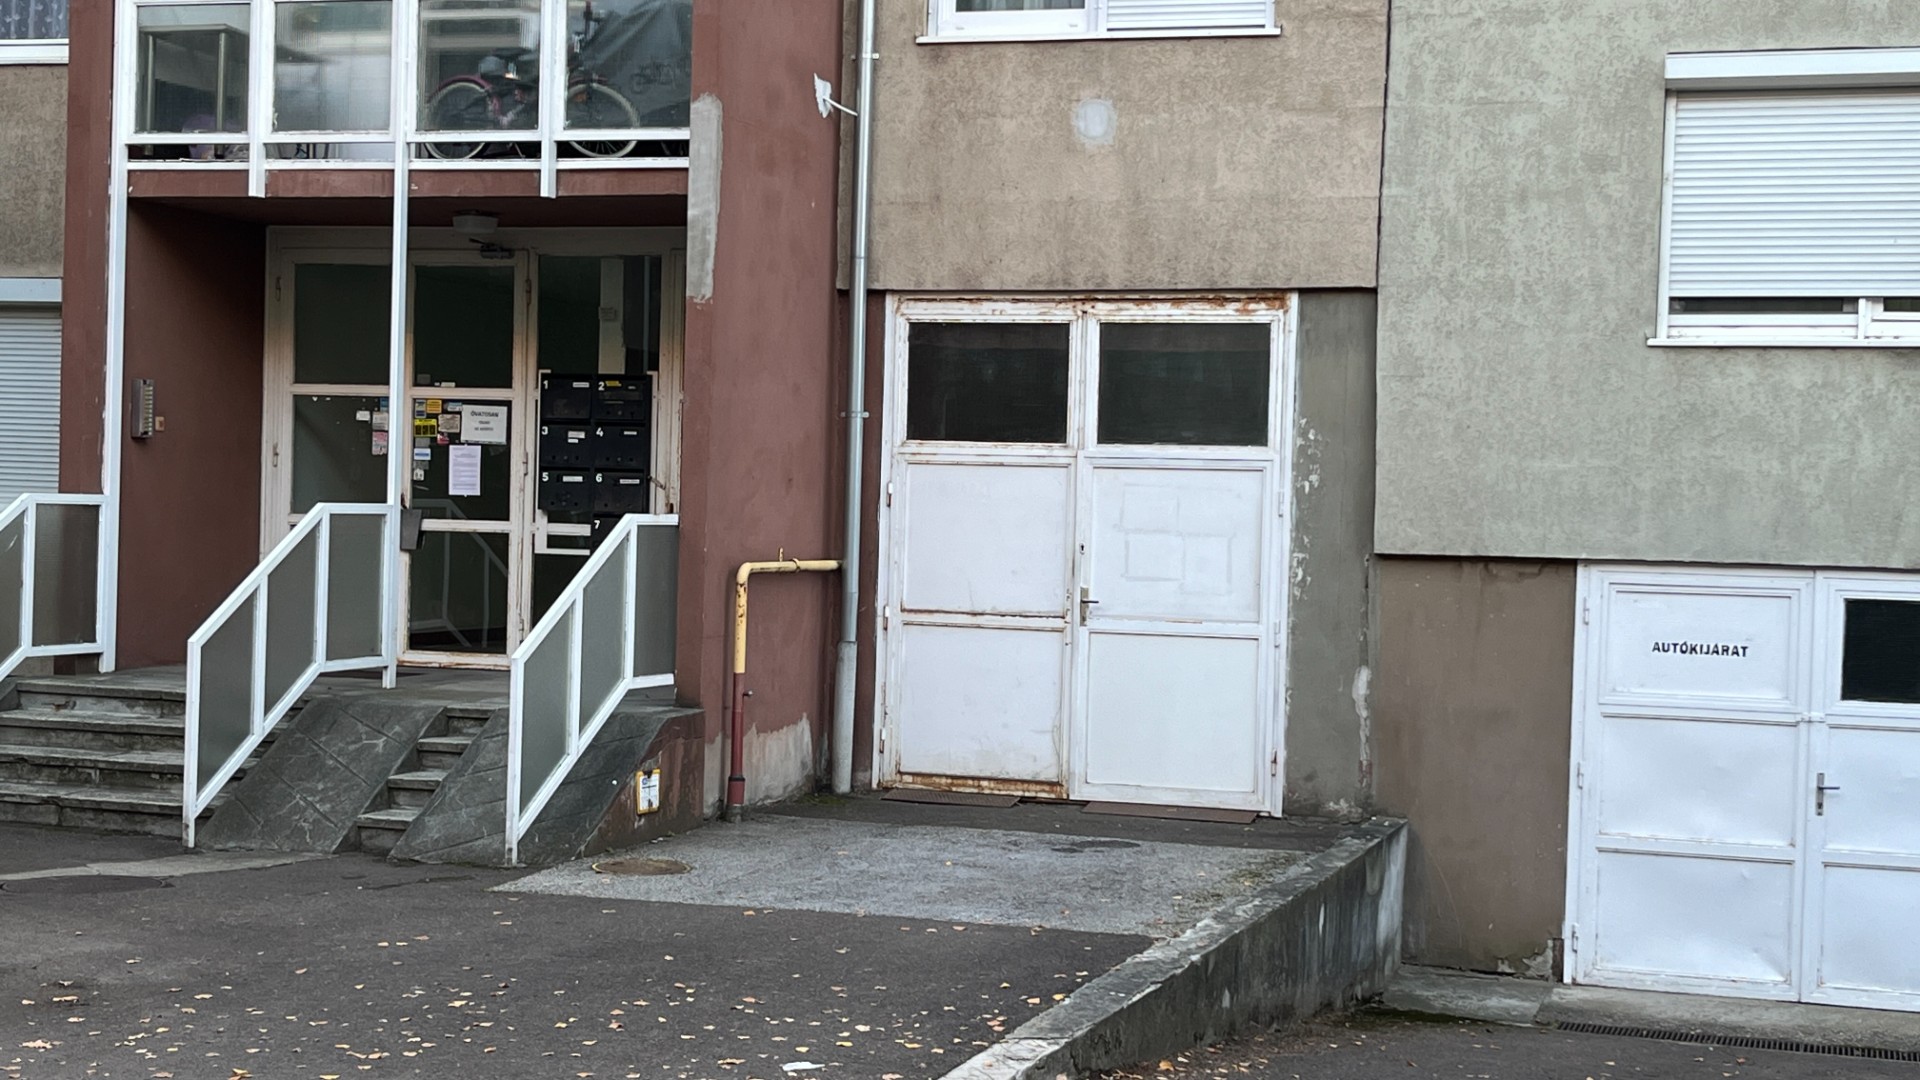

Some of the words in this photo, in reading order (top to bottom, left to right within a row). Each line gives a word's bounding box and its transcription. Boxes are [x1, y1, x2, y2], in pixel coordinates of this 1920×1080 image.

[543, 380, 549, 390] 1
[598, 382, 605, 391] 2
[541, 426, 549, 435] 3
[596, 427, 604, 437] 4
[542, 472, 549, 482] 5
[595, 473, 603, 483] 6
[594, 520, 600, 530] 7
[1652, 641, 1749, 657] AUTÓKIJÁRAT
